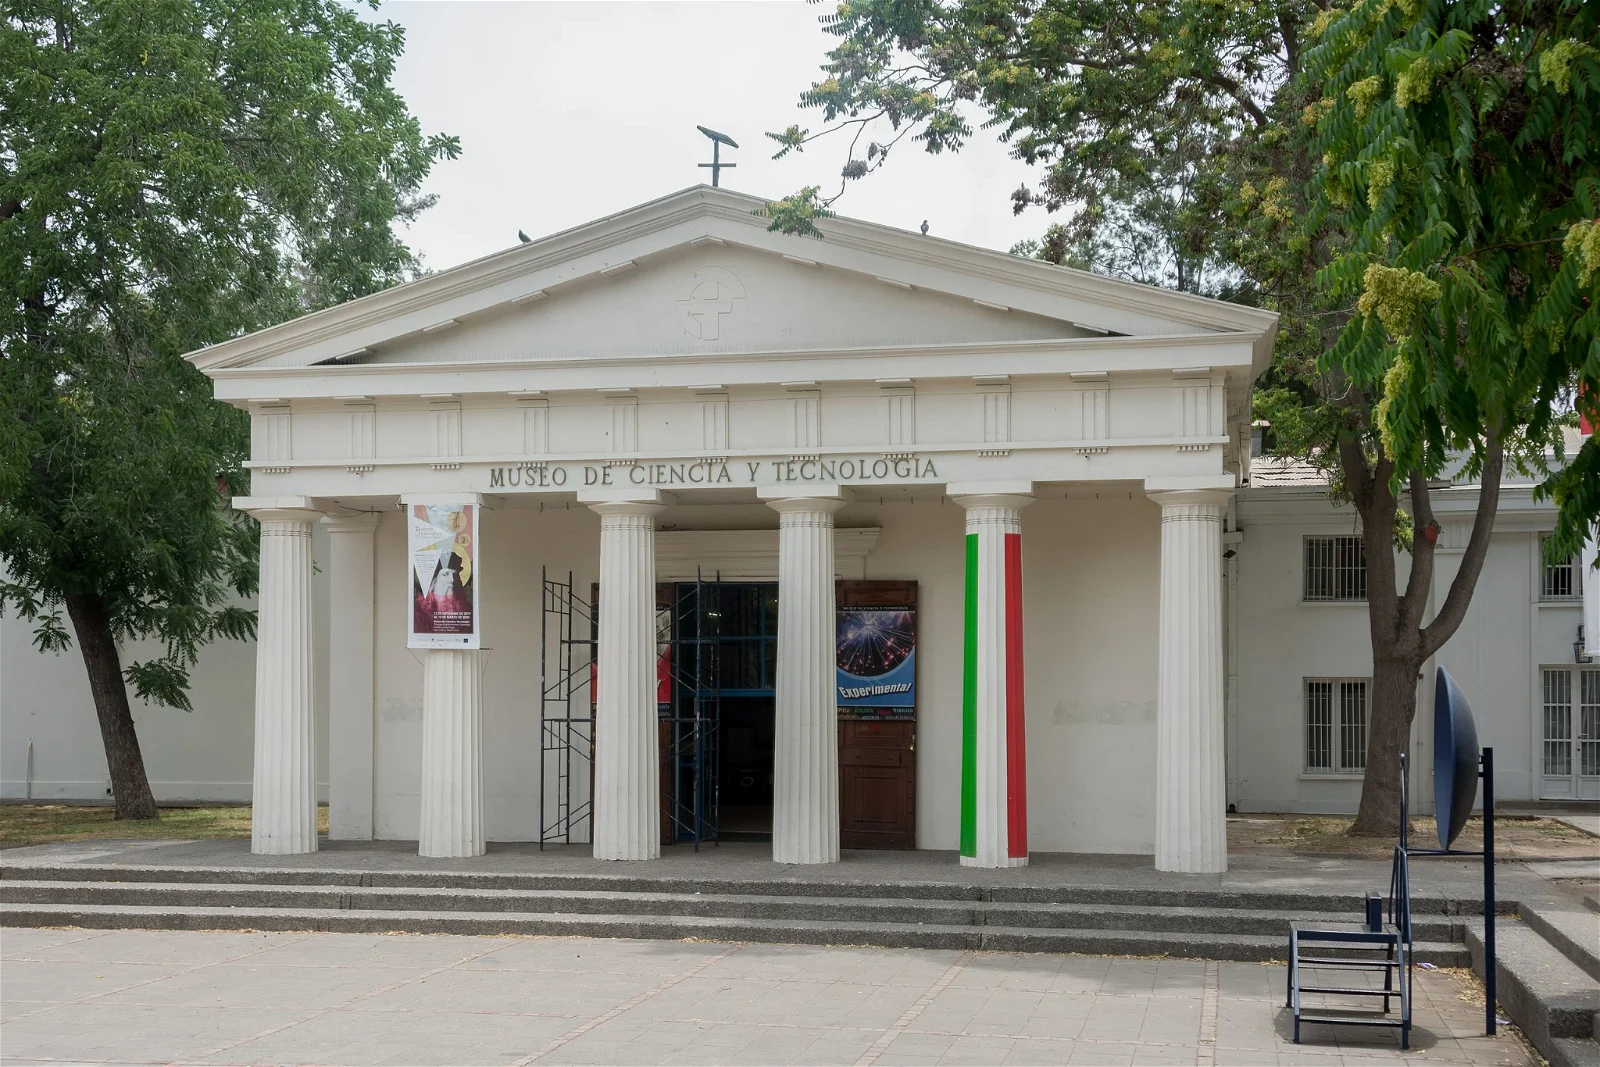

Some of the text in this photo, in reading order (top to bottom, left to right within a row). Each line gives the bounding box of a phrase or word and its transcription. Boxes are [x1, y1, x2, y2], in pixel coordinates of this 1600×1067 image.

[489, 458, 938, 487] MUSEO DE CIENCIA Y TECNOLOGIA
